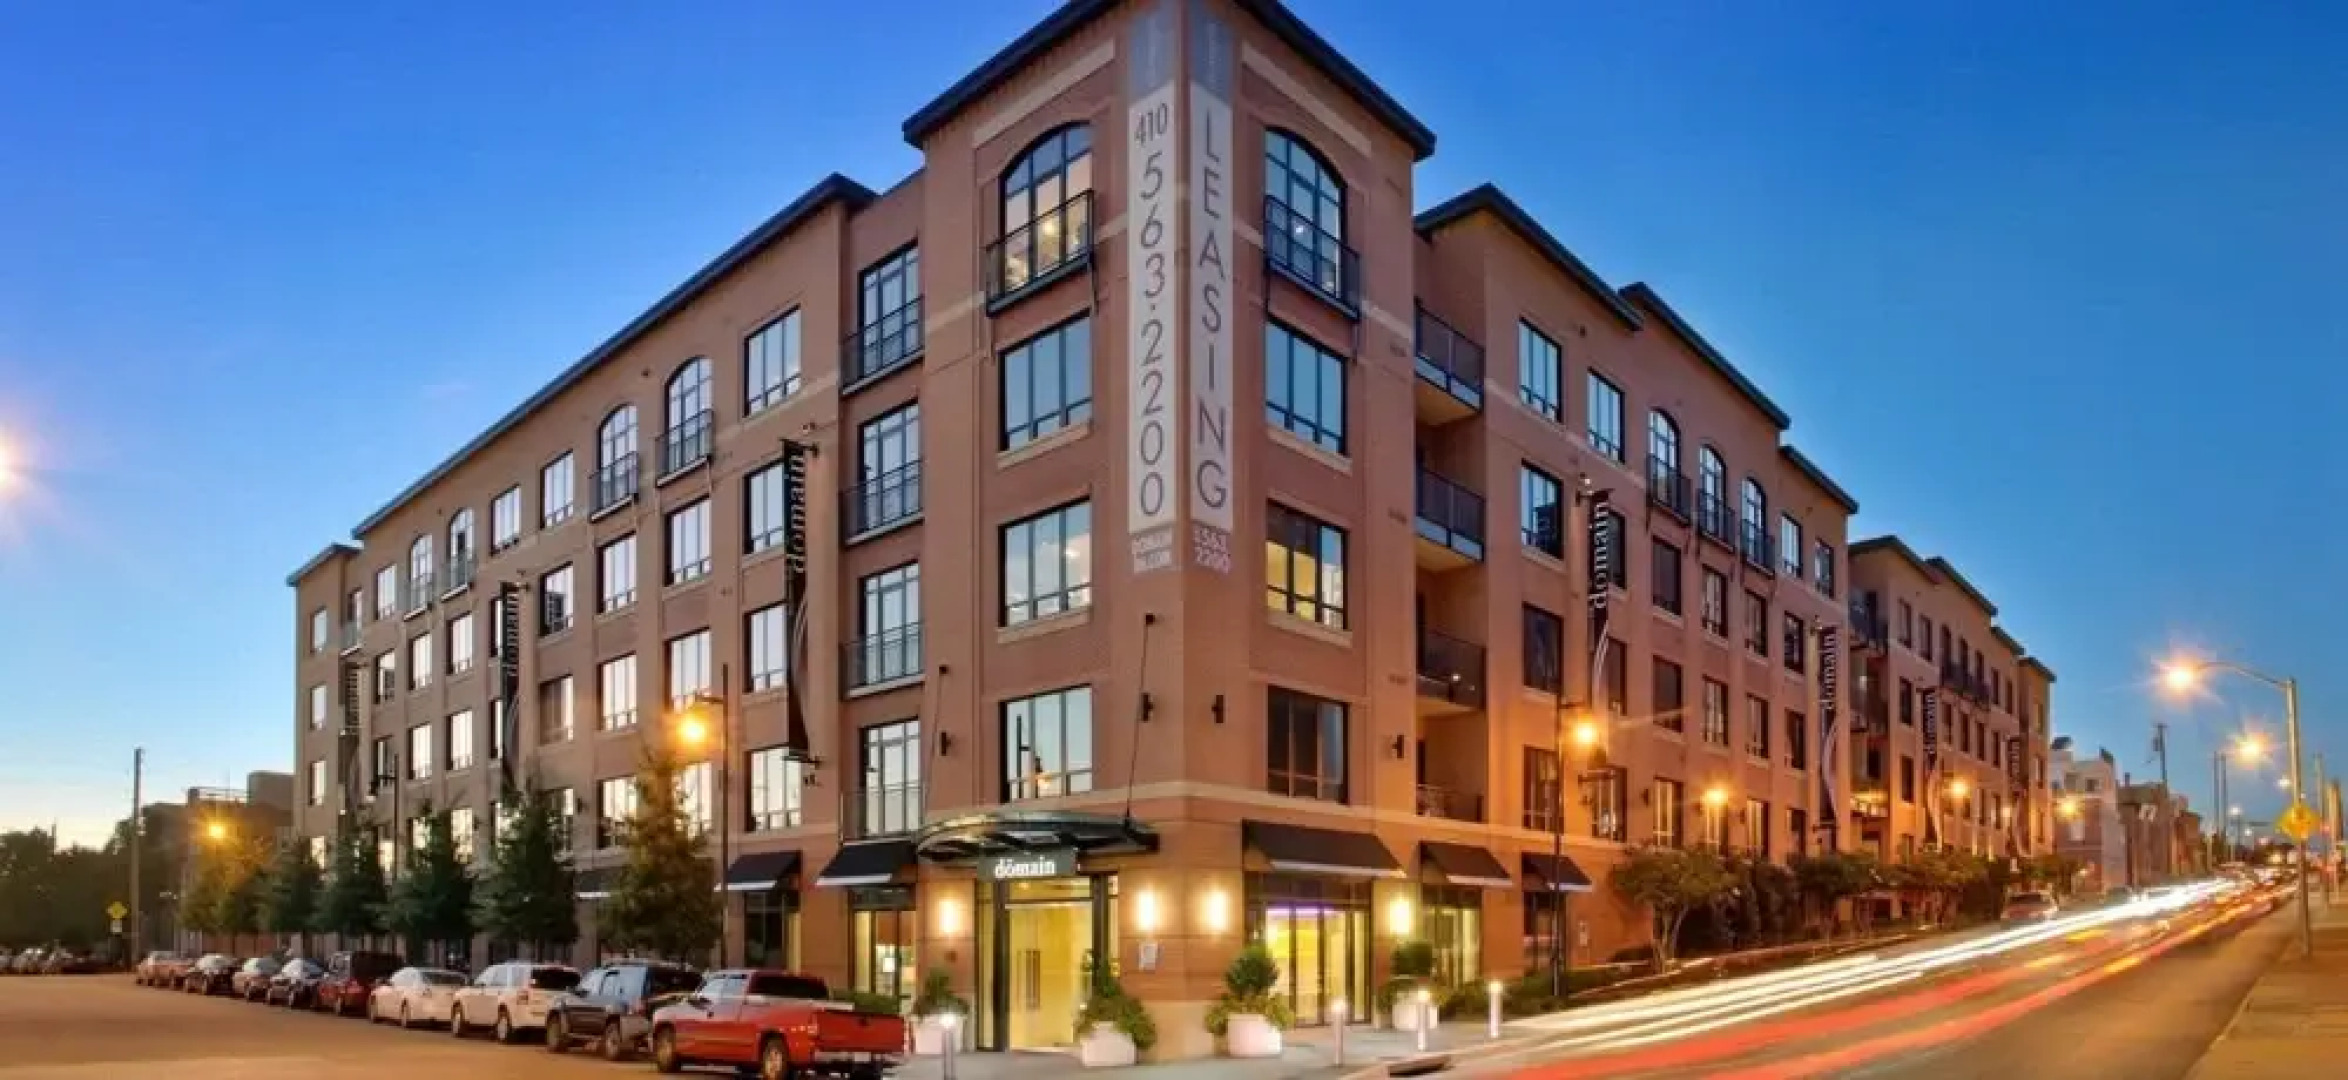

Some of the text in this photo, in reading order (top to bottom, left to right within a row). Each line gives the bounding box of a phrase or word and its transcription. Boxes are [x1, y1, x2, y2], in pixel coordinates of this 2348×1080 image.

[1134, 102, 1168, 147] 410
[1197, 108, 1227, 508] LEASING
[783, 454, 805, 573] domain
[1588, 501, 1608, 609] domain
